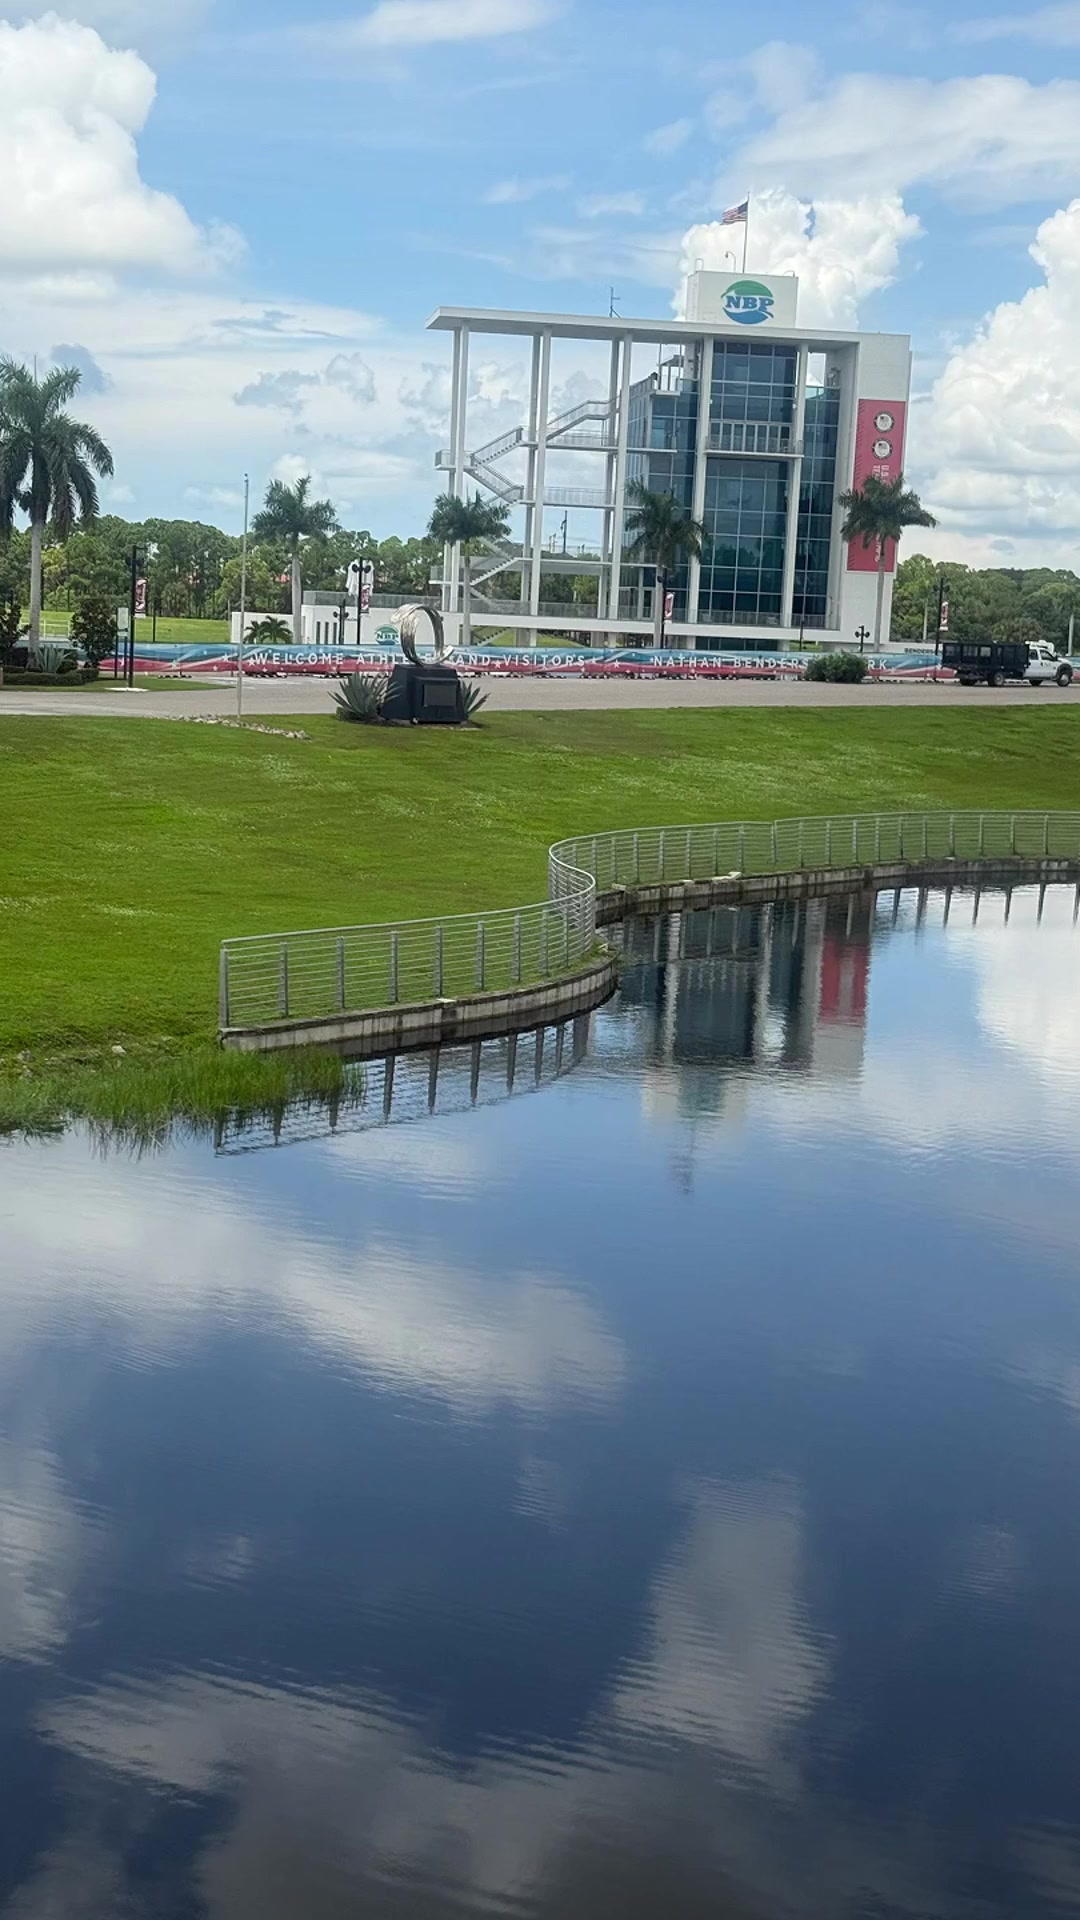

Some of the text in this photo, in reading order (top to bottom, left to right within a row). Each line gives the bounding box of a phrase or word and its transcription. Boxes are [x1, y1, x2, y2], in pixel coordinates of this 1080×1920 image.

[725, 295, 774, 312] NBP
[254, 652, 344, 665] WELCOME
[455, 655, 492, 666] AND
[503, 654, 585, 666] VISITORS
[653, 655, 722, 668] NATHAN
[734, 657, 809, 669] BENDERS
